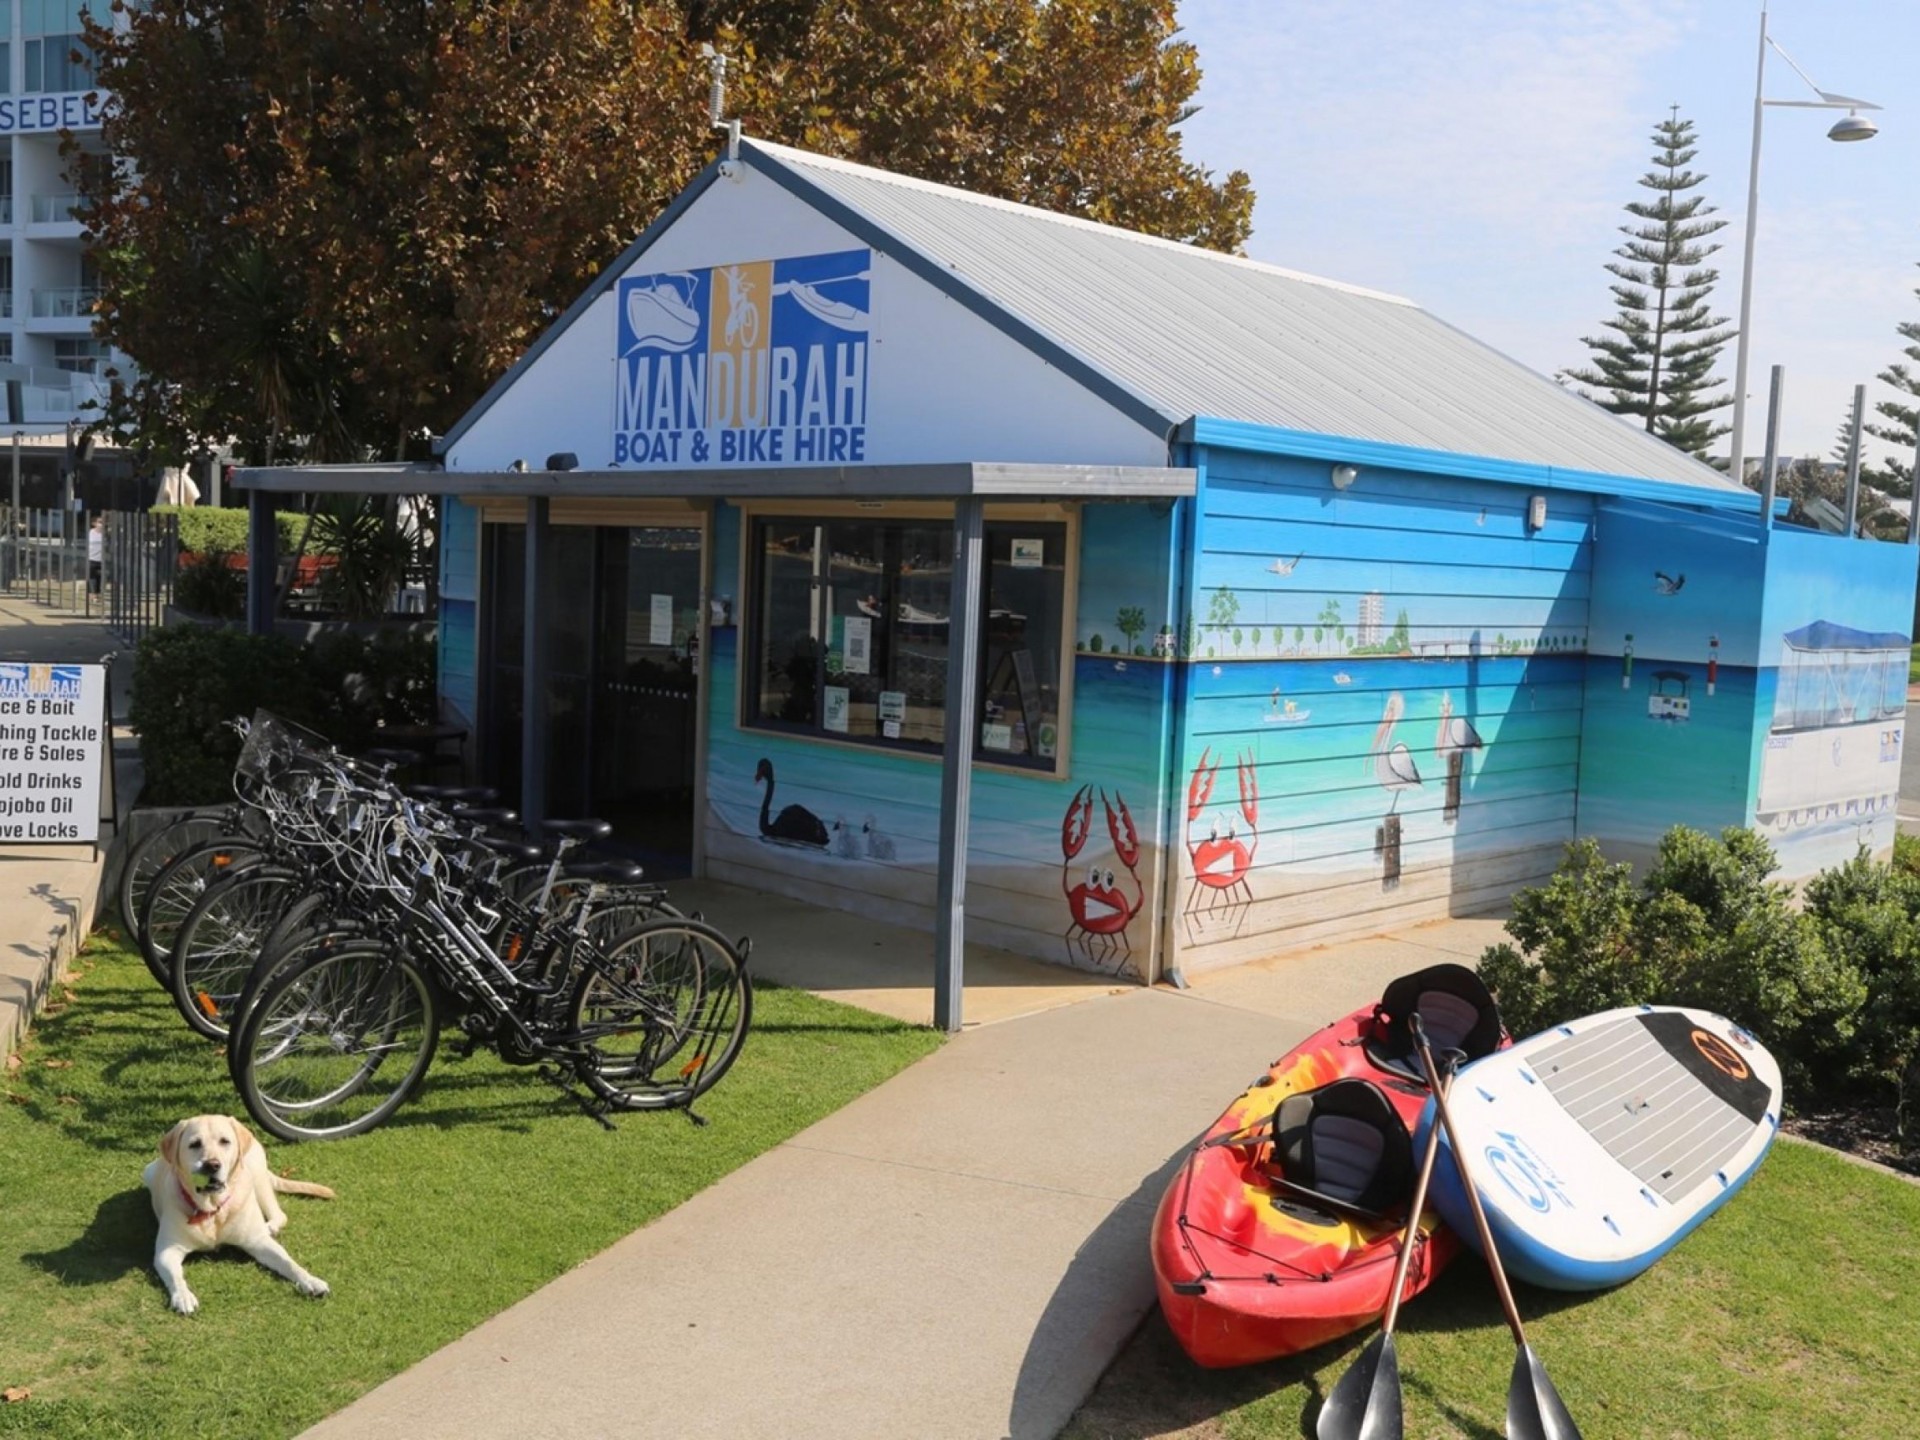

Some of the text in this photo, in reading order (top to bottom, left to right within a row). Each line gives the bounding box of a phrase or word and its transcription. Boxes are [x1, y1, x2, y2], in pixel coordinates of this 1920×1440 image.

[616, 342, 866, 430] MANDURAH
[614, 428, 866, 463] BOAT & BIKE HIRE
[26, 699, 36, 715] &
[42, 699, 75, 715] Bait
[42, 724, 97, 741] Tackle
[0, 744, 85, 761] re & Sales
[28, 772, 82, 789] Drinks
[51, 797, 73, 813] Oil
[0, 821, 78, 838] ve Locks
[436, 934, 509, 1011] NORCO
